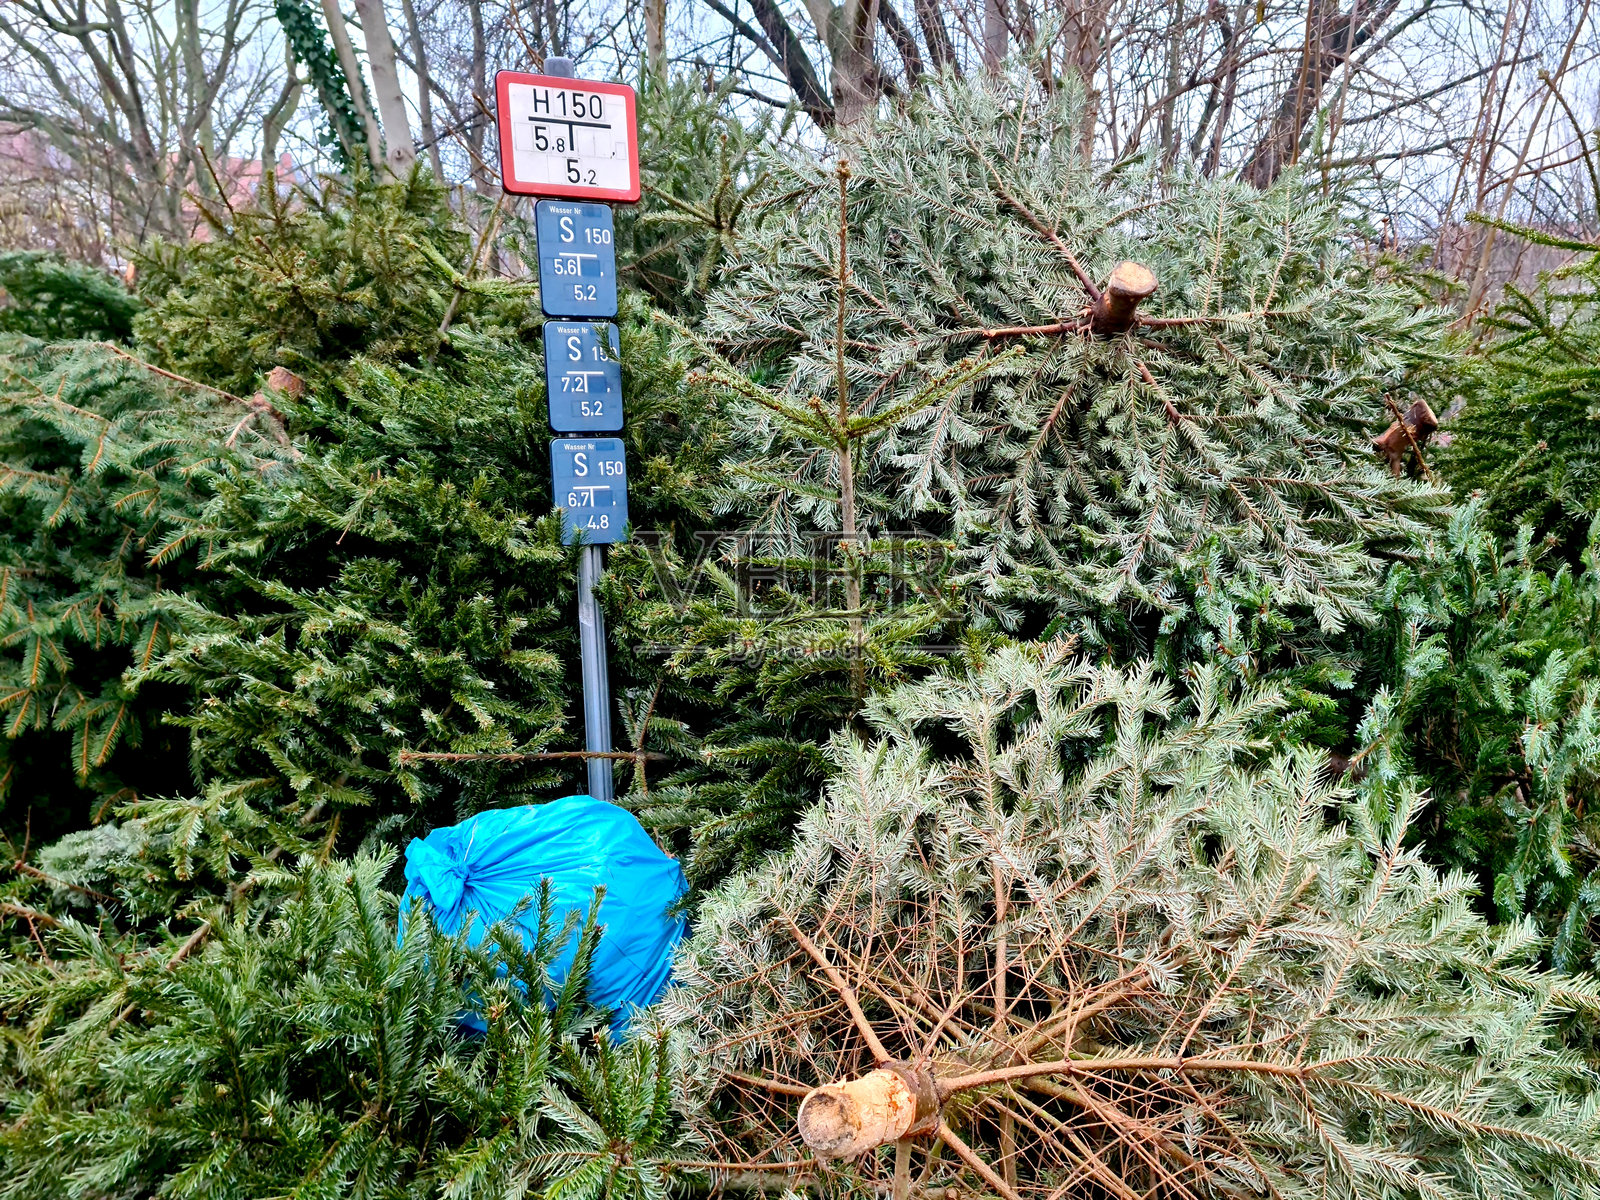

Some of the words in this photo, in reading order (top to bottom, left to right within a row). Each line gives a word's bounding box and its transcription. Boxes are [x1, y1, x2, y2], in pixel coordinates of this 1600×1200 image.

[549, 206, 572, 214] Wasser
[560, 216, 575, 243] S
[584, 228, 611, 244] 150
[557, 326, 579, 334] Wasser
[567, 336, 581, 361] S
[574, 452, 588, 476] S
[598, 461, 623, 476] 150
